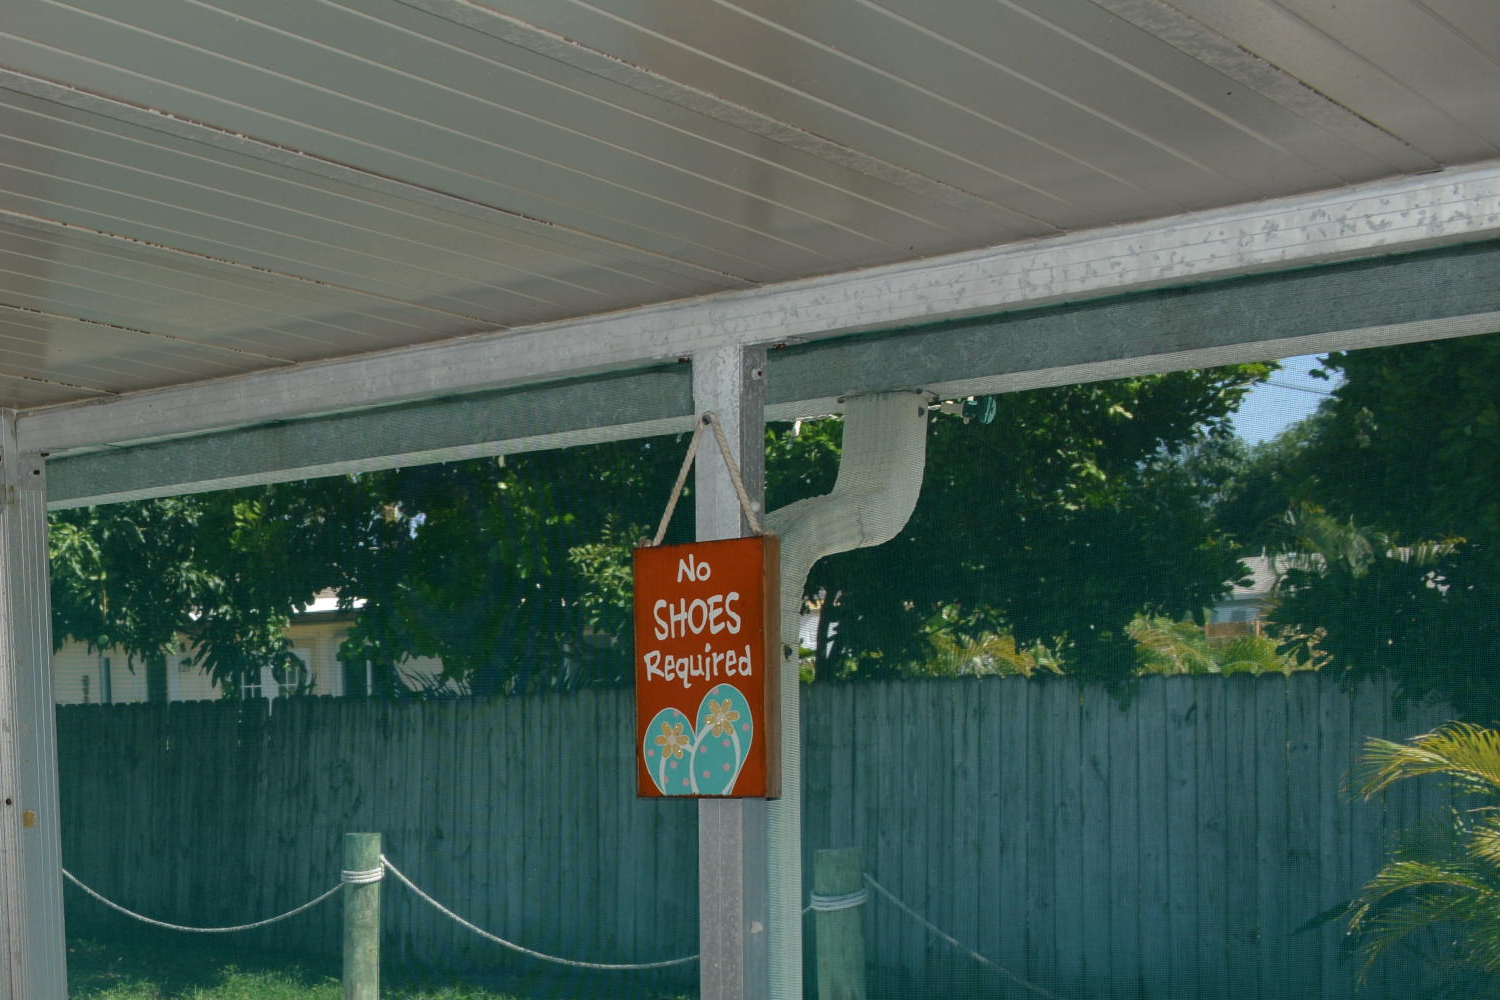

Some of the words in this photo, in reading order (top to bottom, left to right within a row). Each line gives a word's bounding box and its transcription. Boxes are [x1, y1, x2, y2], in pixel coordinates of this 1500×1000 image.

[677, 554, 711, 582] No
[653, 592, 741, 640] SHOES
[644, 643, 752, 688] Required
